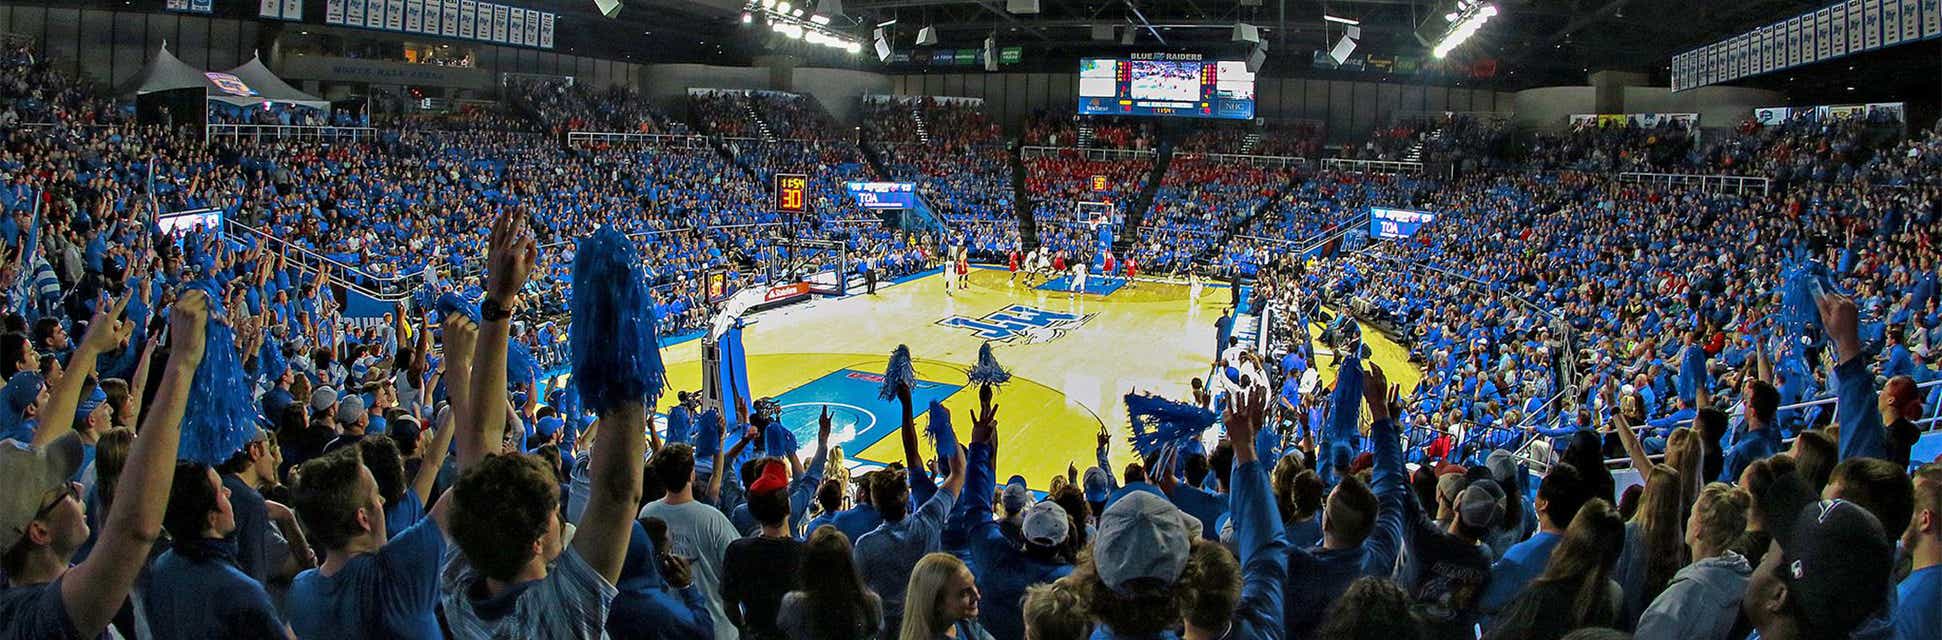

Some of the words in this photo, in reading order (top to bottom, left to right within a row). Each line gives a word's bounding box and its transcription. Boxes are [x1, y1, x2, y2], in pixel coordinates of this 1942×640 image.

[1130, 52, 1152, 60] BLUE
[1165, 53, 1202, 61] RAIDERS
[781, 178, 805, 189] 11:54
[783, 189, 802, 208] 30
[858, 193, 878, 203] TOA
[1380, 221, 1398, 233] TOA
